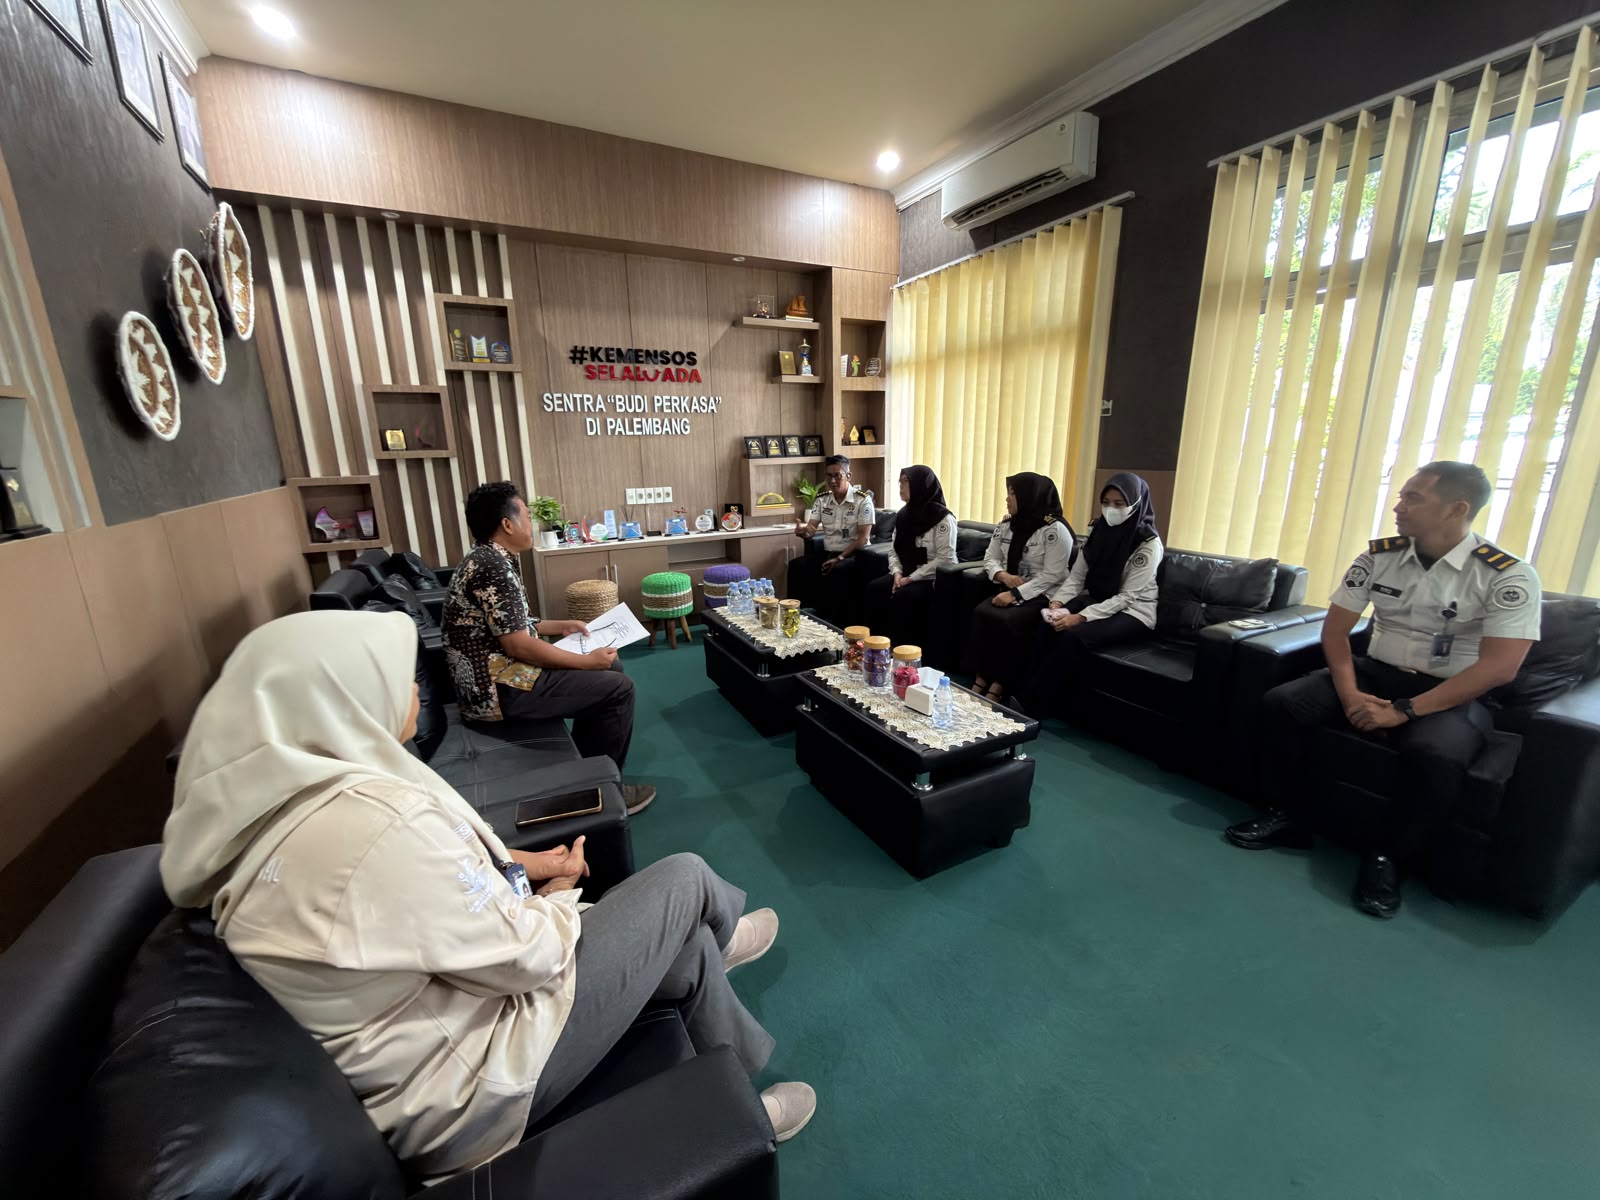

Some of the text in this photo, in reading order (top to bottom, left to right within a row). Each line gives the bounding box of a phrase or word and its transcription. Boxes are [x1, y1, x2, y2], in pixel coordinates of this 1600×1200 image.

[569, 345, 698, 366] #KEMENSOS
[662, 367, 702, 383] ADA
[543, 392, 607, 412] SENTRA
[586, 417, 691, 436] DI PALEMBANG
